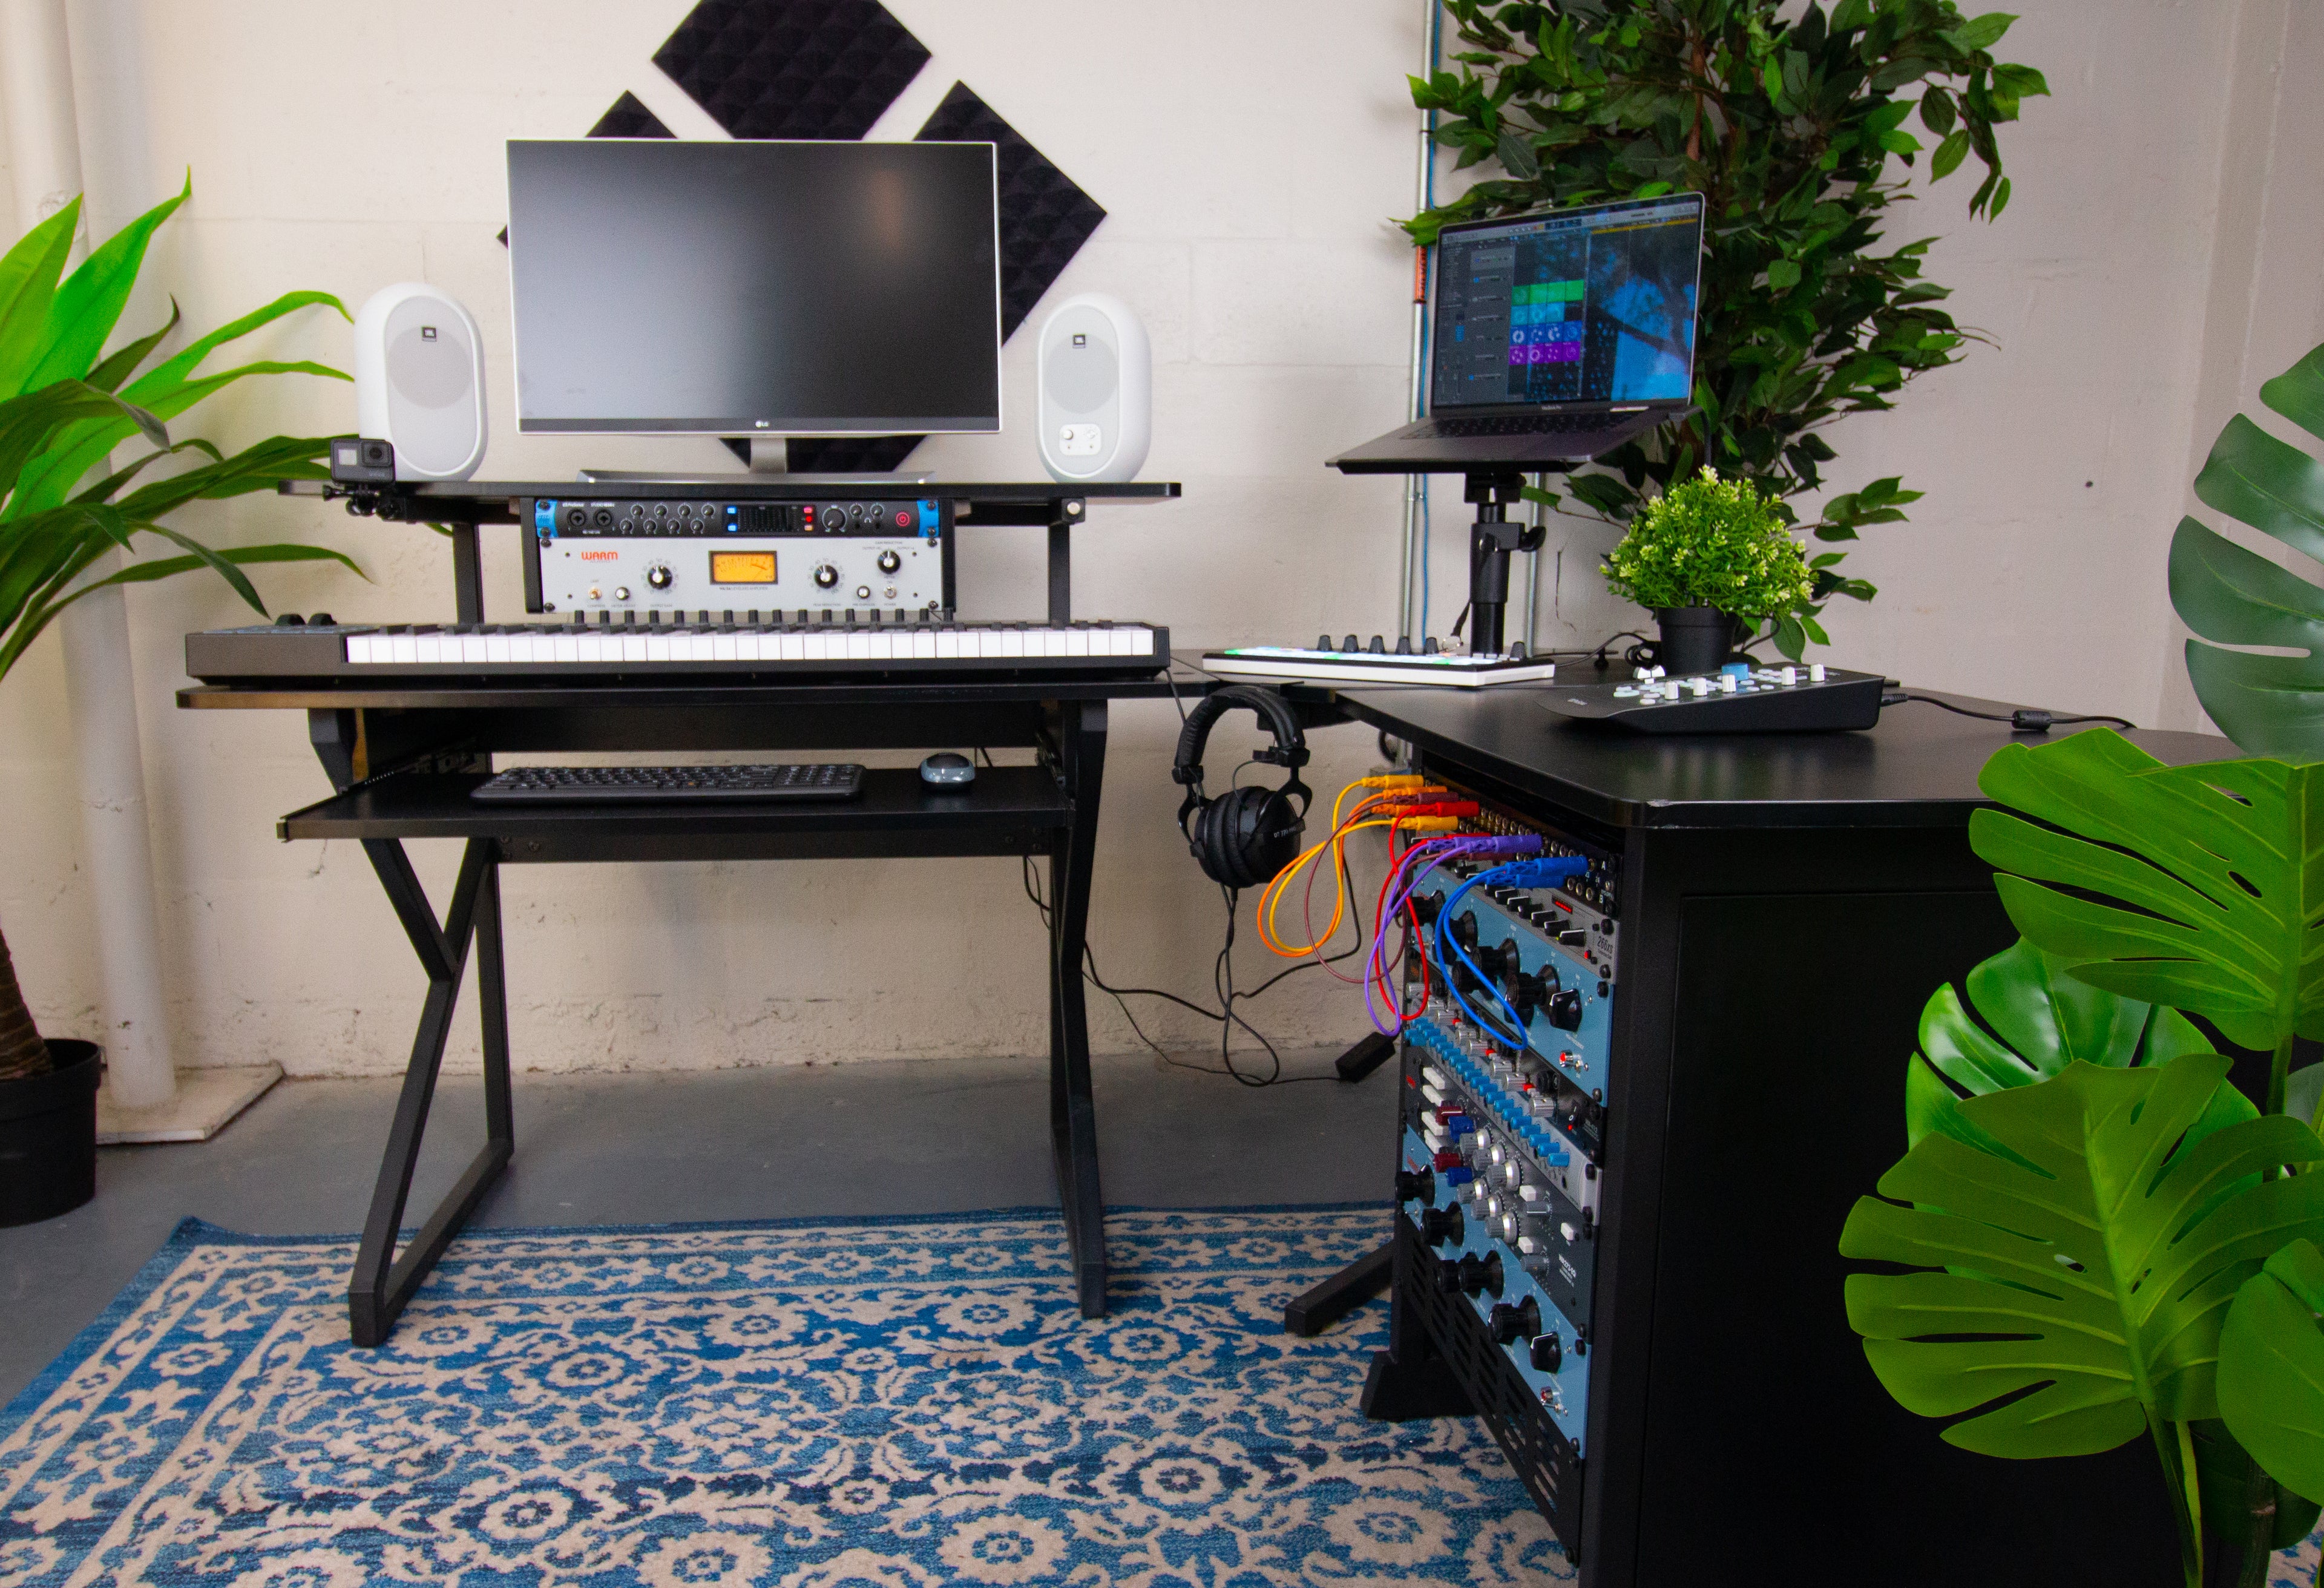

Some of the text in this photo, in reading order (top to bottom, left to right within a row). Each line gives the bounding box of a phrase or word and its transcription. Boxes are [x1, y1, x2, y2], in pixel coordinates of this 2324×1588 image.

[581, 551, 618, 560] WARM
[1601, 861, 1606, 870] A
[1599, 894, 1604, 904] B
